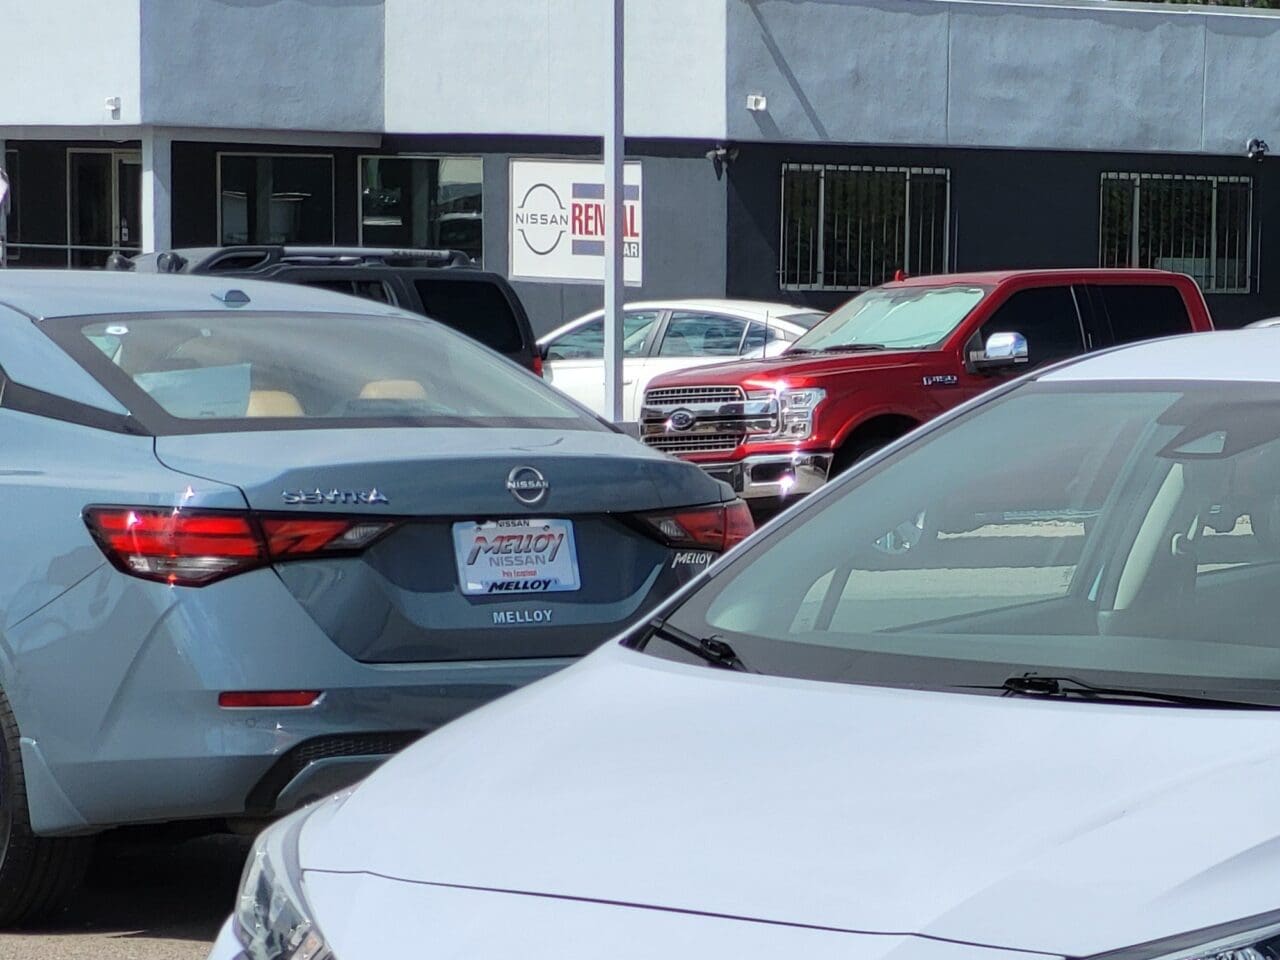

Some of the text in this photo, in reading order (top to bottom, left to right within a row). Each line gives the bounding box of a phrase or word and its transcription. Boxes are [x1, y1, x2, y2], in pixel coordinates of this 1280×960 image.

[515, 213, 568, 226] NISSAN
[571, 203, 640, 237] RENL
[507, 480, 549, 489] NISSAN
[280, 488, 390, 505] SENTRA
[496, 520, 530, 528] NISSAN
[466, 533, 565, 566] MELLOY
[489, 555, 546, 567] NISSAN
[671, 552, 713, 569] MELLOY
[488, 579, 553, 593] MELLOY
[493, 610, 553, 624] MELLOY
